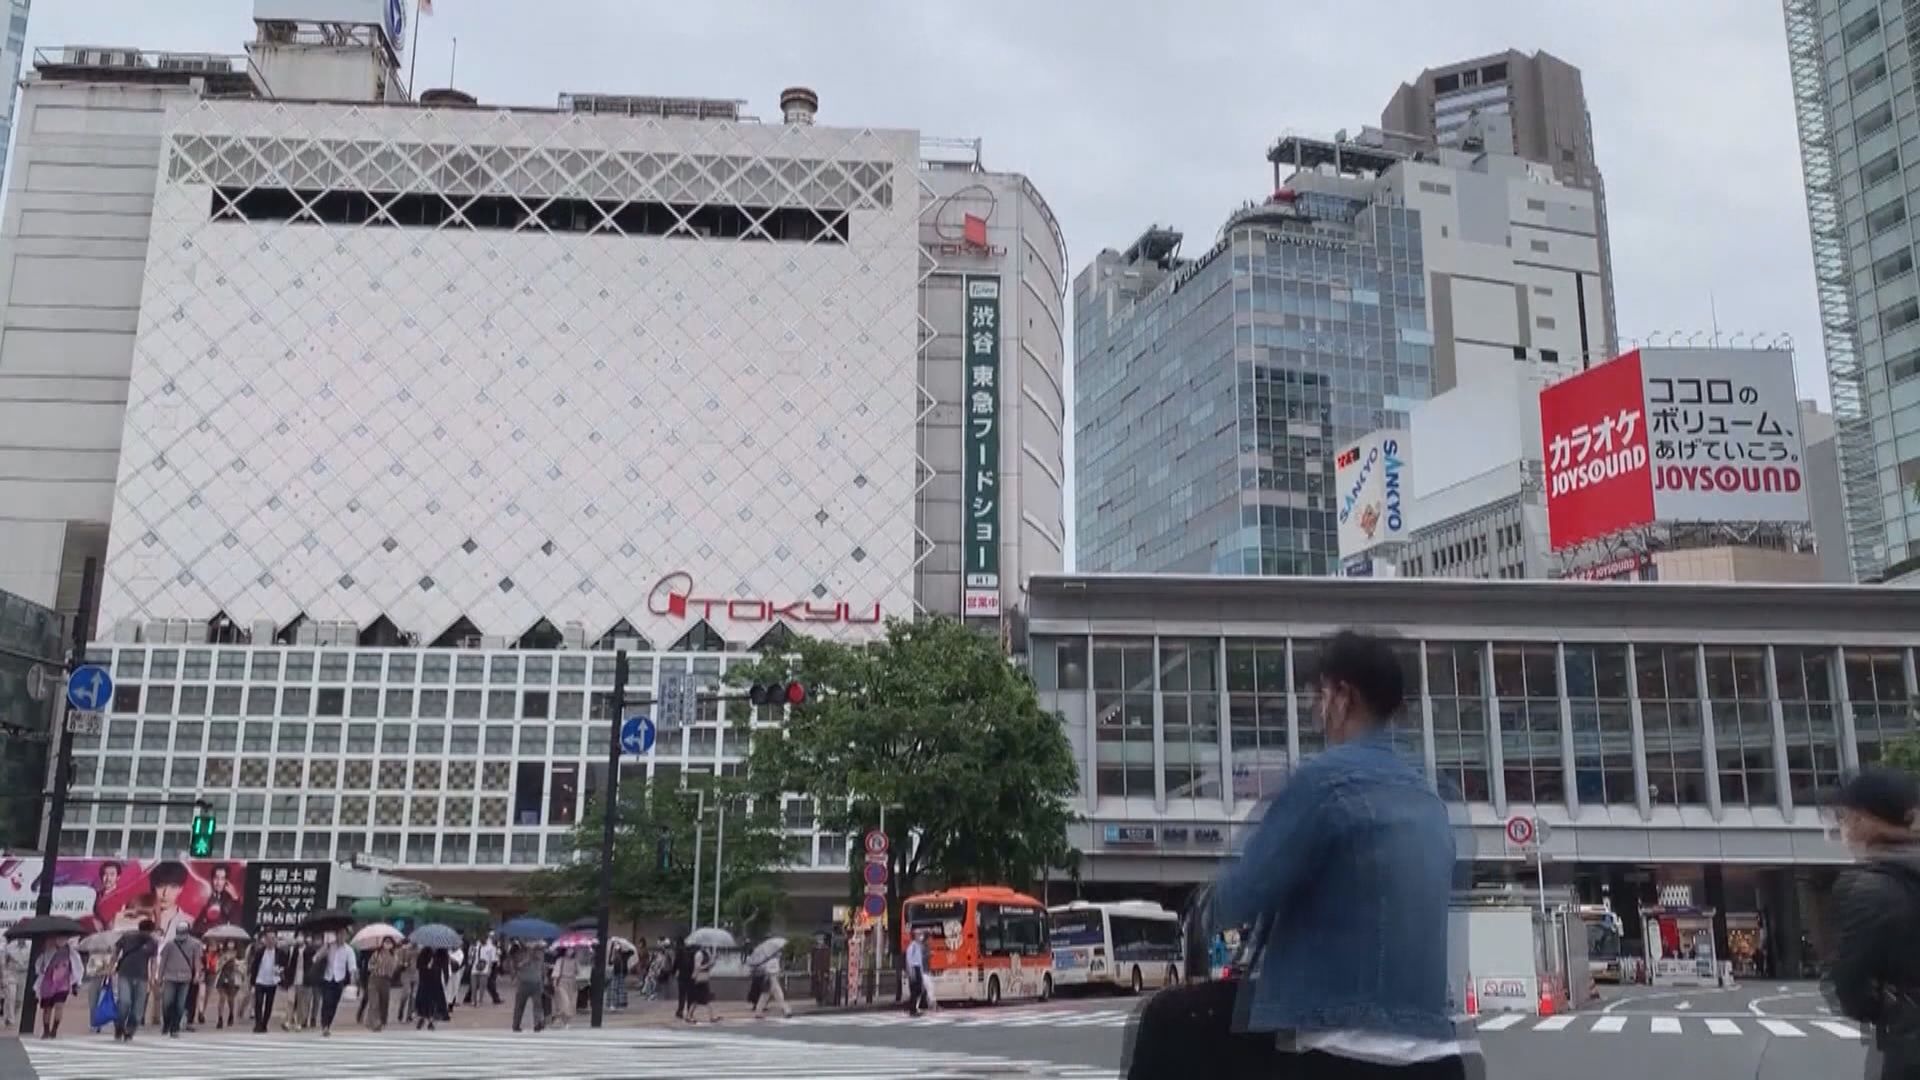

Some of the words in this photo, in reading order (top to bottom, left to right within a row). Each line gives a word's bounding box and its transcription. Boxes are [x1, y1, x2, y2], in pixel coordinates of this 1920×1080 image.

[972, 305, 994, 355] 渋谷
[1649, 378, 1758, 405] ココロの
[1652, 408, 1795, 437] ボリューム、
[1550, 409, 1641, 471] カラオケ
[1655, 439, 1799, 463] あげていこう。
[972, 364, 994, 569] 東急フードショー
[1551, 445, 1647, 498] JOYSOUND
[1655, 465, 1801, 493] JOYSOUND
[1339, 447, 1378, 525] SANKYO
[1383, 440, 1405, 532] SANKYO
[687, 599, 881, 624] TOKYU
[967, 595, 998, 609] 営業中
[260, 867, 318, 883] 毎週土曜
